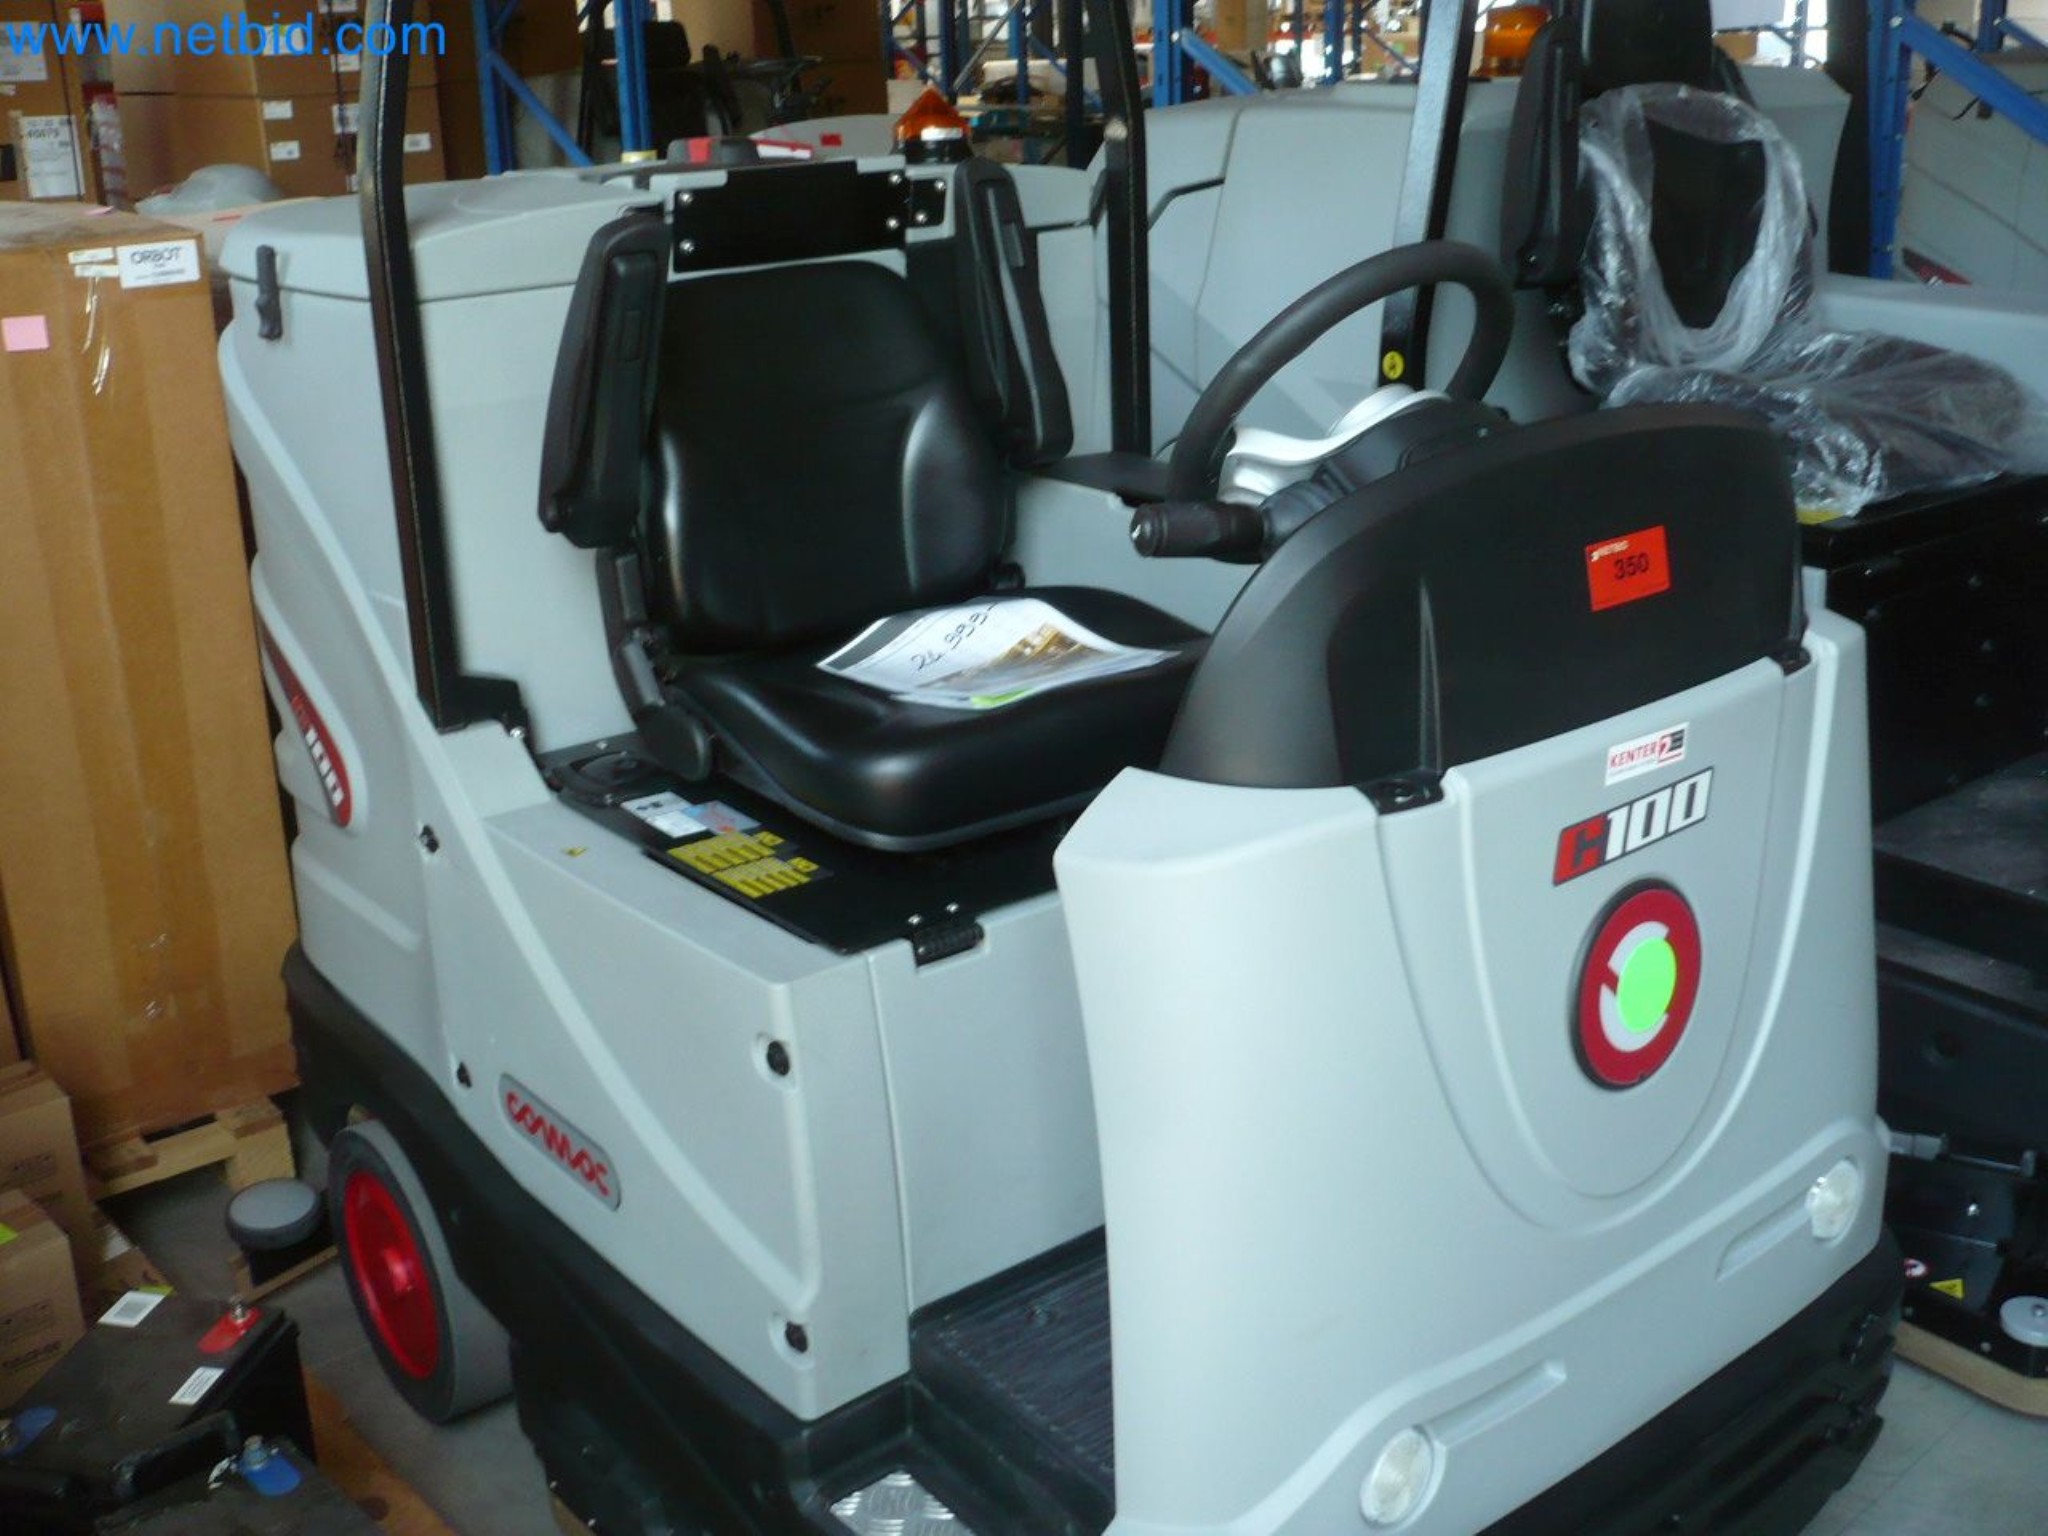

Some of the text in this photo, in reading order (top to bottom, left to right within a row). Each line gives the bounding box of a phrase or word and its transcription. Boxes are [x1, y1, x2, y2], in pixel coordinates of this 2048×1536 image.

[1614, 552, 1649, 580] 350
[1610, 741, 1657, 768] KENTER
[1553, 769, 1713, 886] C100
